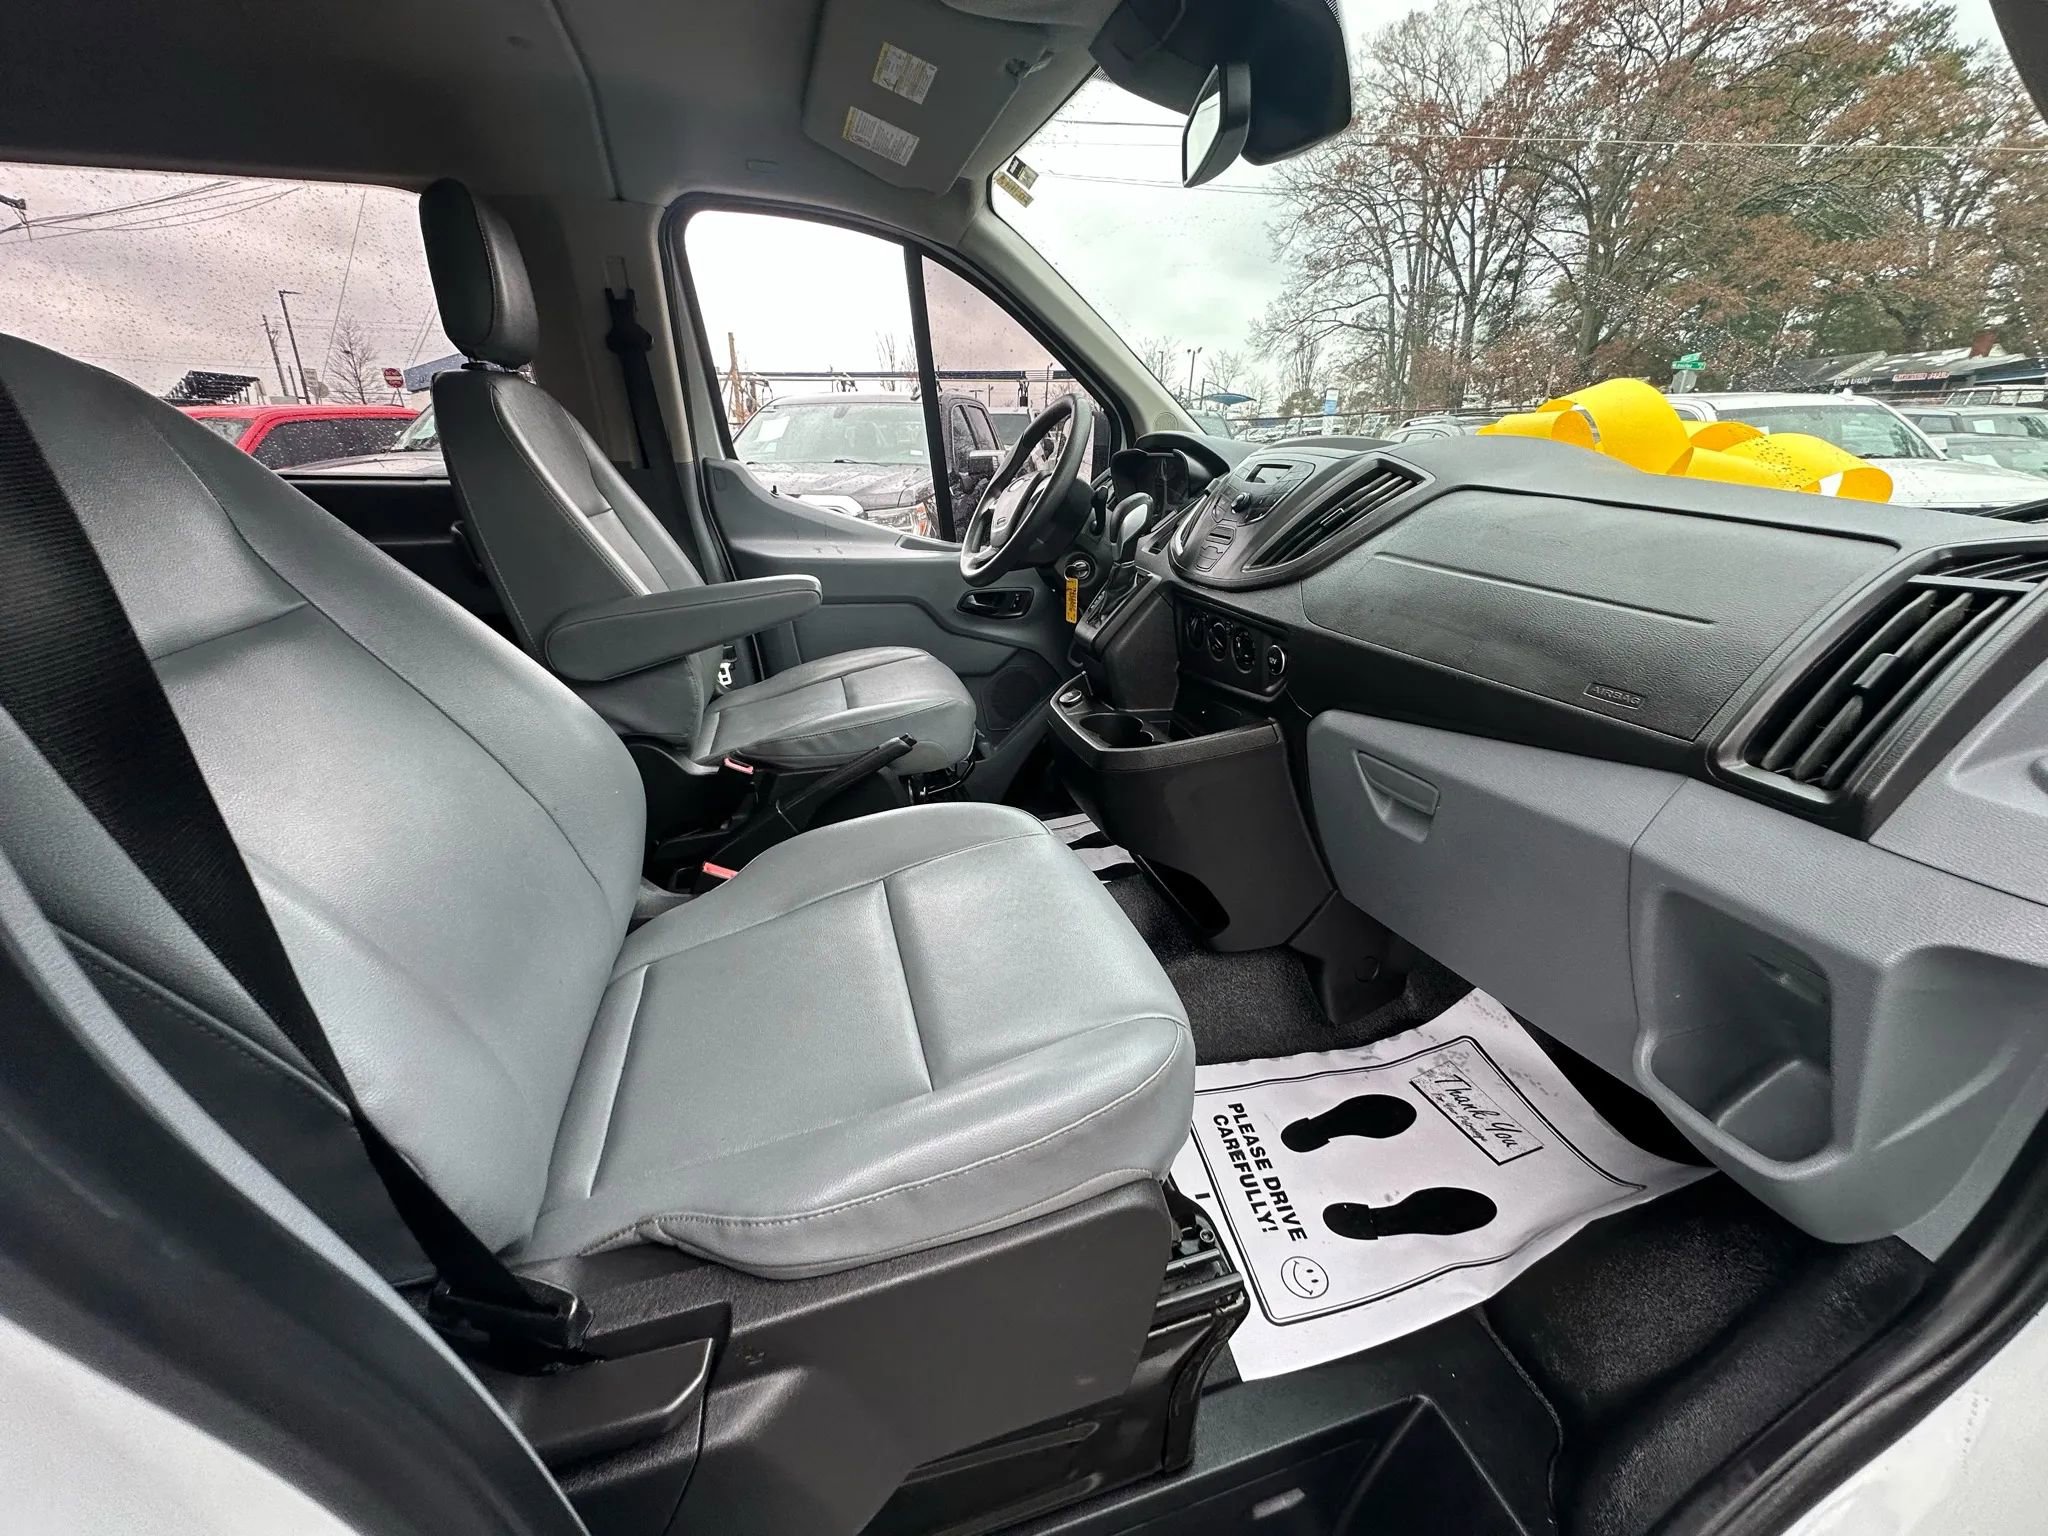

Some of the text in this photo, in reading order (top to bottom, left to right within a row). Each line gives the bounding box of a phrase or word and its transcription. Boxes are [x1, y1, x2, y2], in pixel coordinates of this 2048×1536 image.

[1592, 685, 1641, 705] AIRBAG
[1434, 1073, 1522, 1148] Thank You
[1213, 1114, 1279, 1233] CAREFULLY!
[1227, 1102, 1308, 1242] PLEASE DRIVE
